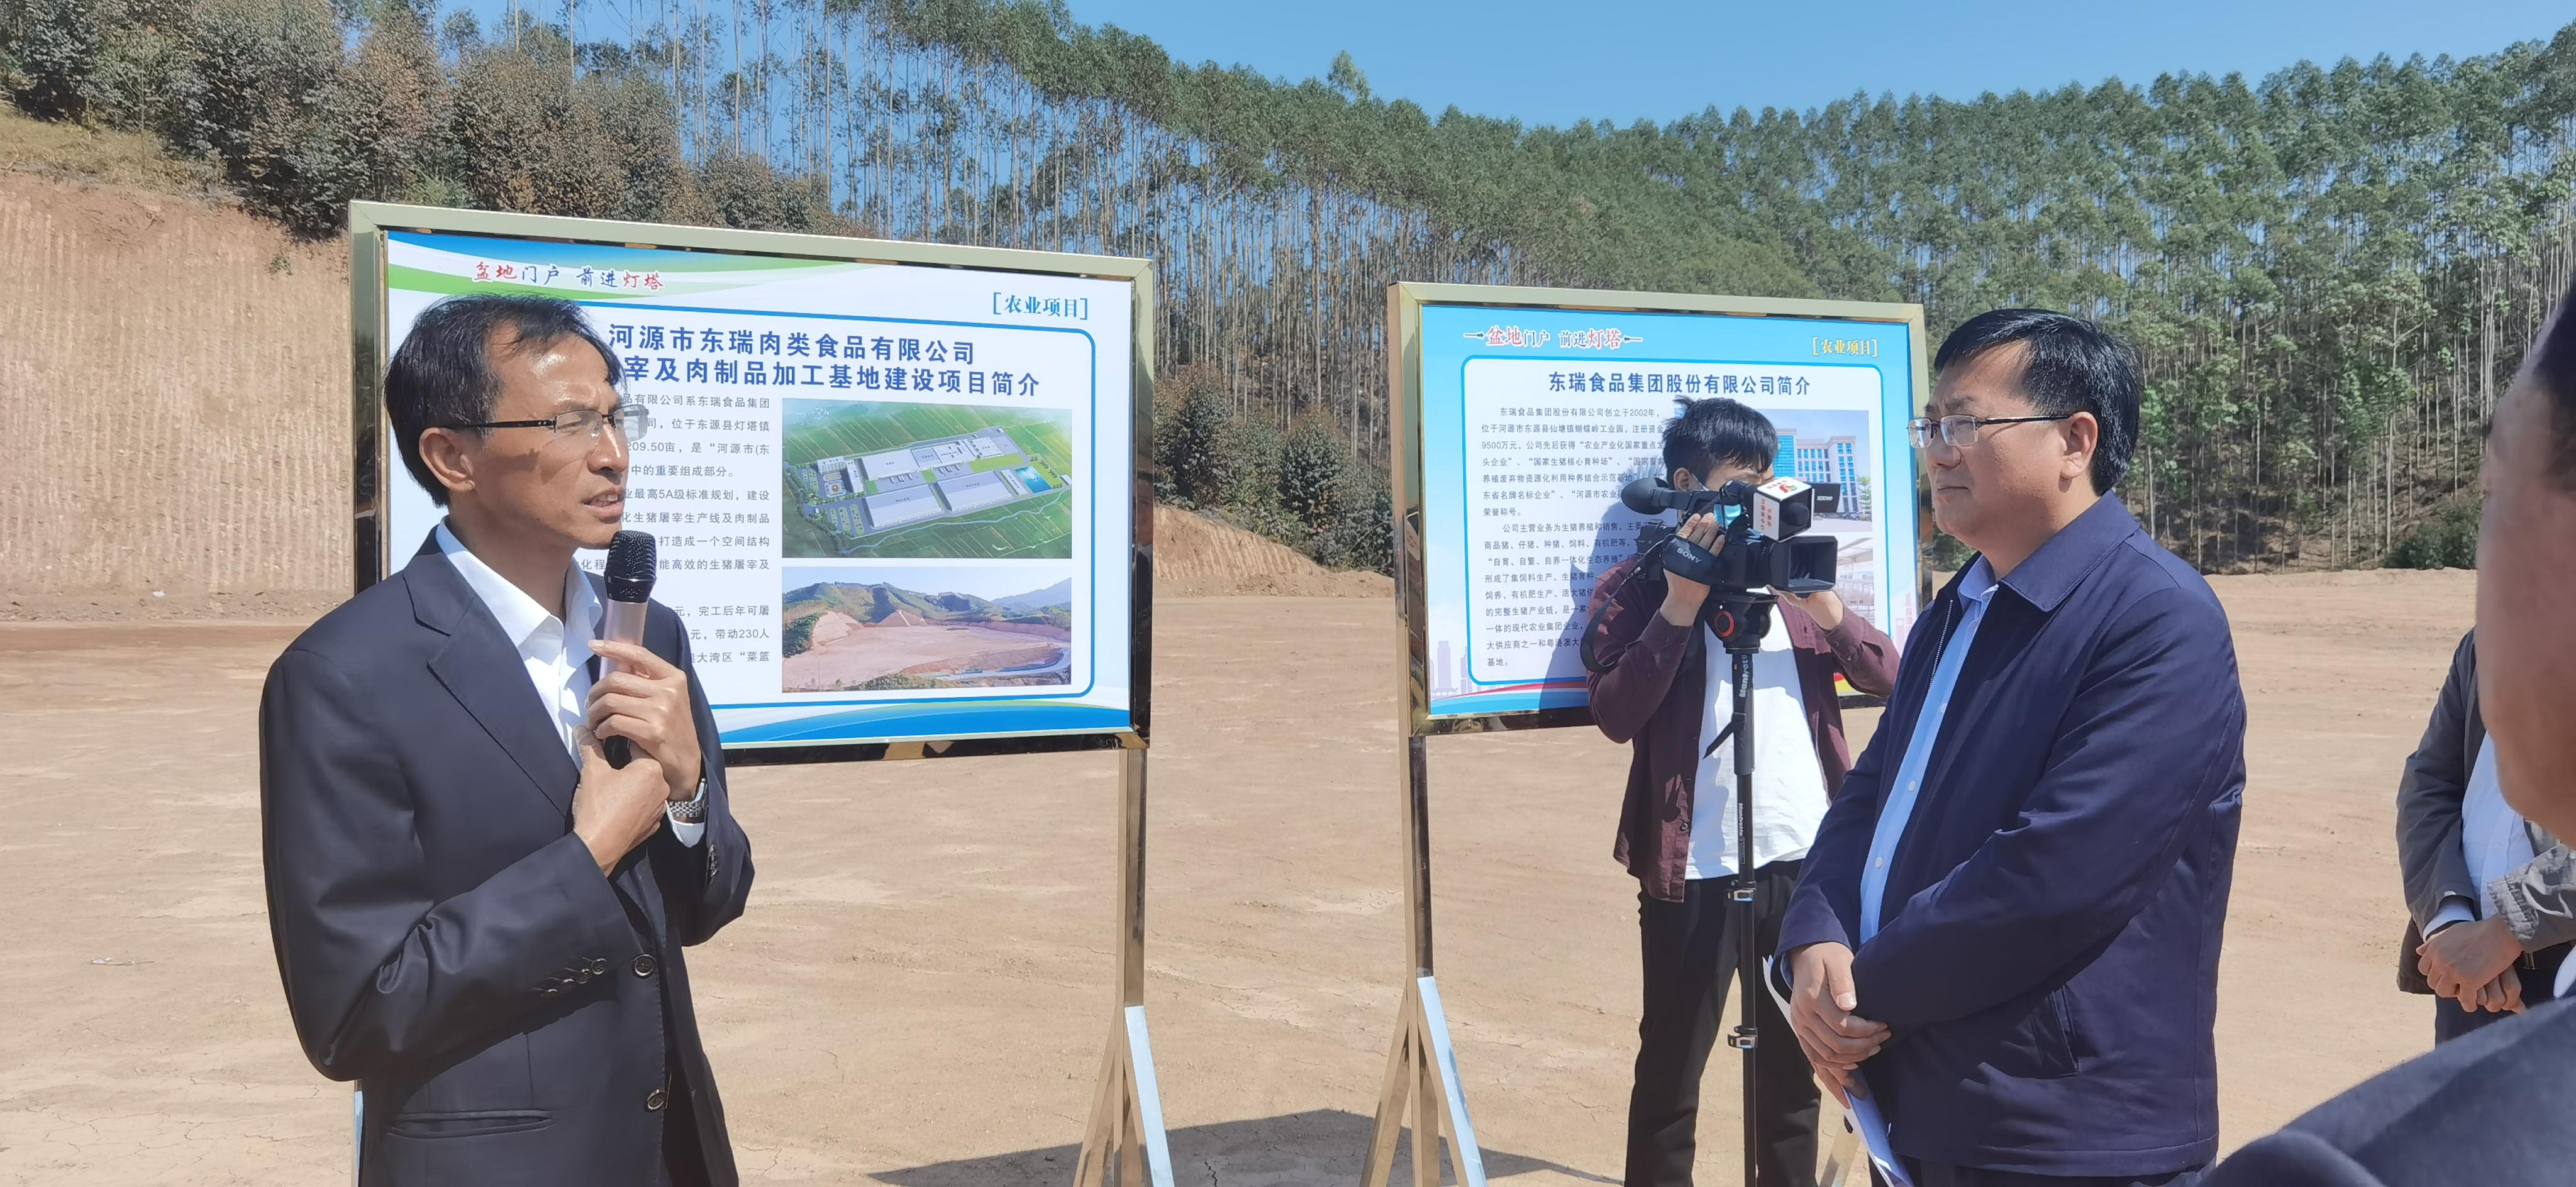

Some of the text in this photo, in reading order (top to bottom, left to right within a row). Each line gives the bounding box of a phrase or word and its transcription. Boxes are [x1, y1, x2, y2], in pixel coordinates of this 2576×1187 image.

[474, 262, 663, 290] 盆地门户 前进灯塔
[993, 292, 1087, 320] [农业项目]
[609, 324, 974, 365] 河源市东瑞肉类食品有限公司
[1487, 326, 1622, 348] 盆地门户 前进灯塔
[1813, 336, 1878, 356] [农业项目]
[1549, 372, 1811, 395] 东瑞食品集团股份有限公司简介
[631, 465, 735, 477] 中的重要组成部分。
[1483, 508, 1521, 517] 荣誉称号。
[659, 536, 770, 547] 打造成一个空间结构
[1677, 547, 1702, 563] SONY
[659, 559, 770, 570] 能高效的生猪屠宰及
[692, 651, 770, 663] 大湾区“菜篮
[1487, 658, 1509, 666] 基地。
